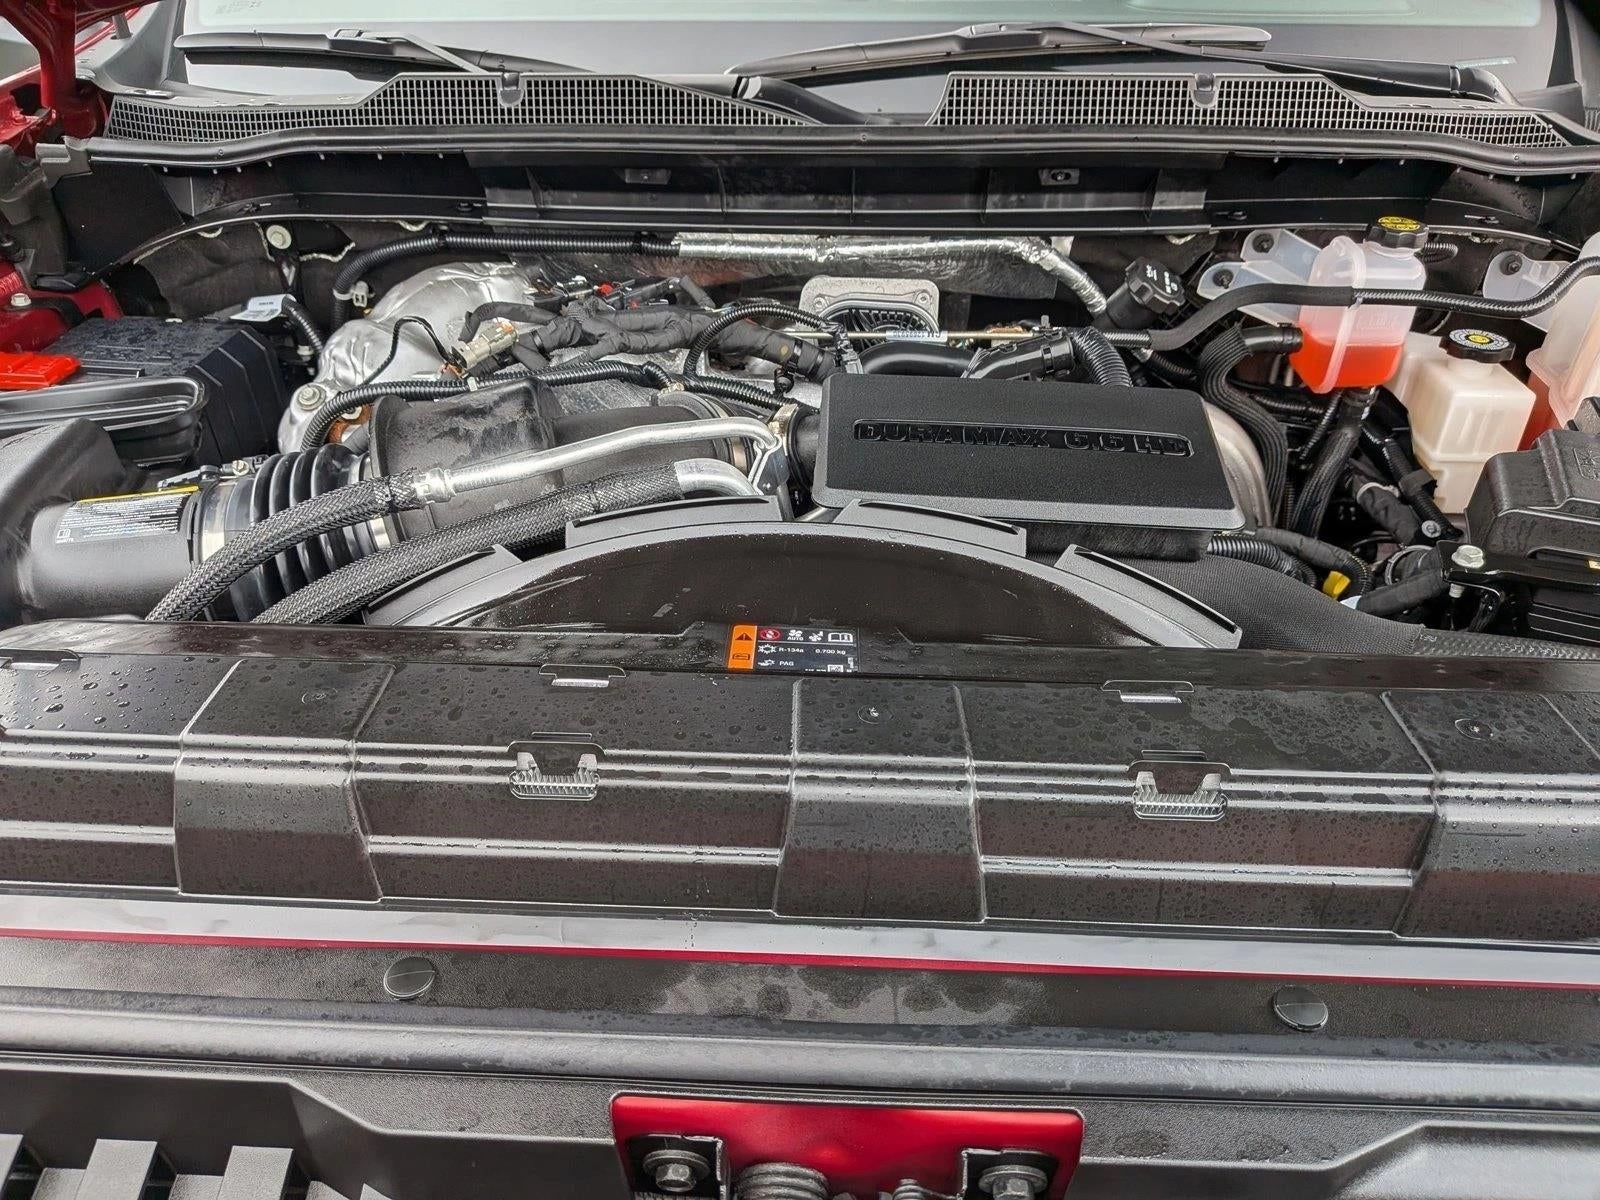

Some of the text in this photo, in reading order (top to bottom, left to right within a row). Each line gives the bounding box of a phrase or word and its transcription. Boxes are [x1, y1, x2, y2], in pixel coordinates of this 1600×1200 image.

[857, 422, 1187, 456] DURAMAX 6.6 HD
